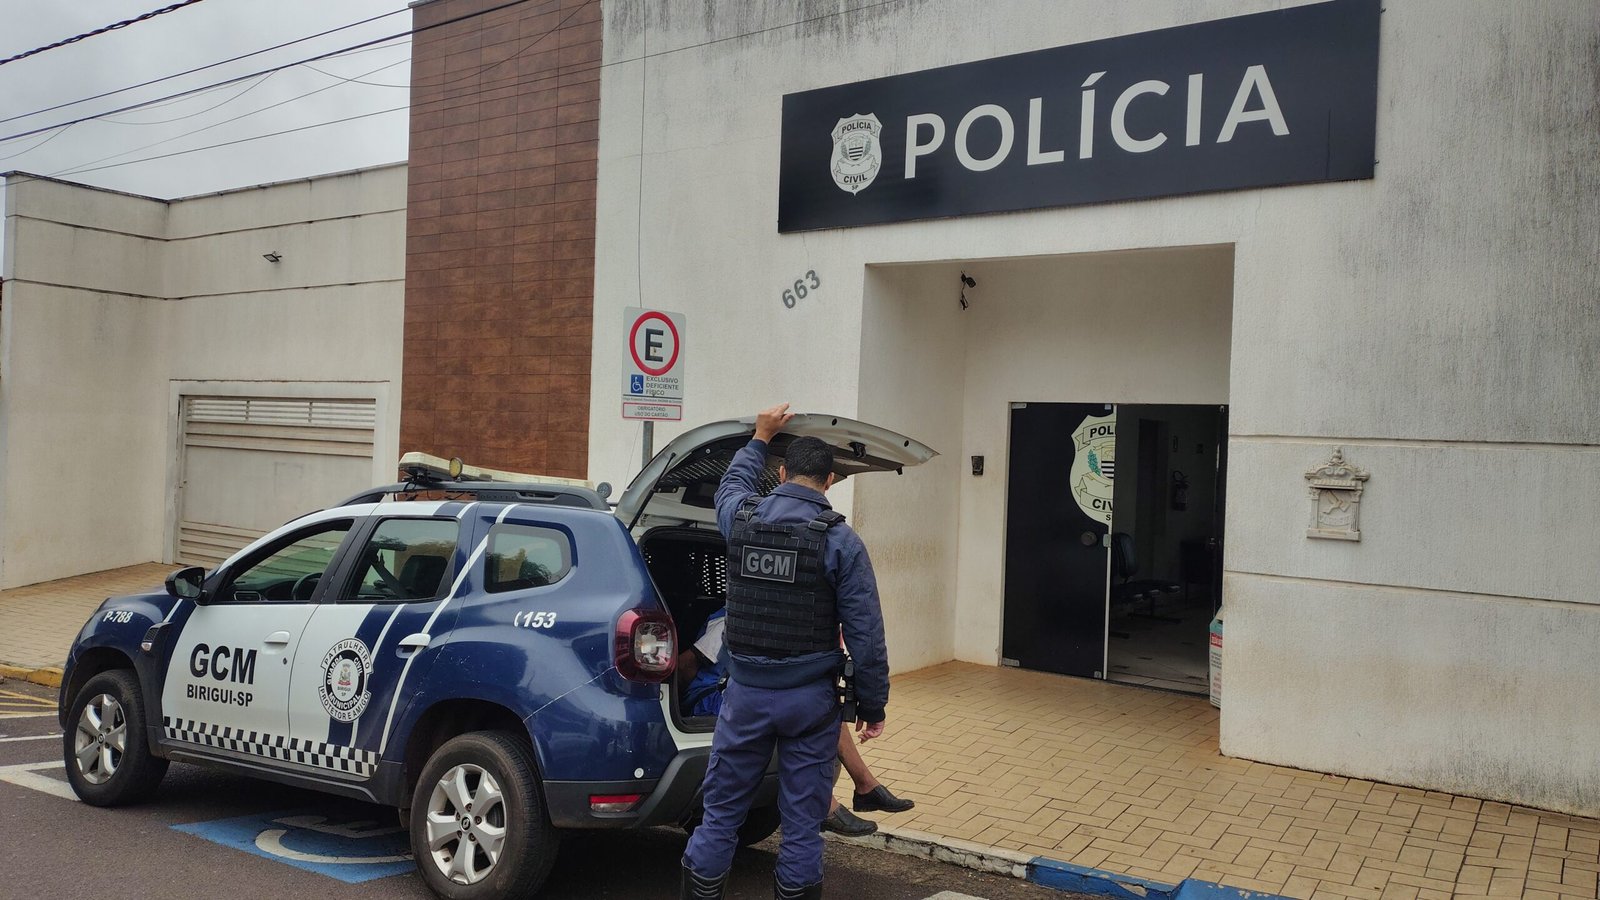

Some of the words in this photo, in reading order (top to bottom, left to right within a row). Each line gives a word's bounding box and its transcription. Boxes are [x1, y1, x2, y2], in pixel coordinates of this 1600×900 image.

[842, 120, 872, 134] POLÍCIA
[904, 64, 1290, 179] POLÍCIA
[843, 174, 868, 183] CIVIL
[782, 269, 821, 309] 663
[645, 328, 664, 362] E
[646, 376, 679, 384] EXCLUSIVO
[645, 388, 665, 396] FÍSICO
[1090, 425, 1116, 438] POL
[746, 552, 791, 577] GCM
[103, 611, 133, 624] P-788
[190, 643, 257, 685] GCM
[324, 641, 370, 669] PATRULHEIRO
[353, 657, 363, 675] CIVIL
[327, 654, 343, 685] GUARDA
[187, 684, 253, 707] BIRIGUI-SP
[320, 688, 347, 720] PROTETOR
[353, 692, 369, 717] AMIGO
[329, 691, 361, 710] MUNICIPAL
